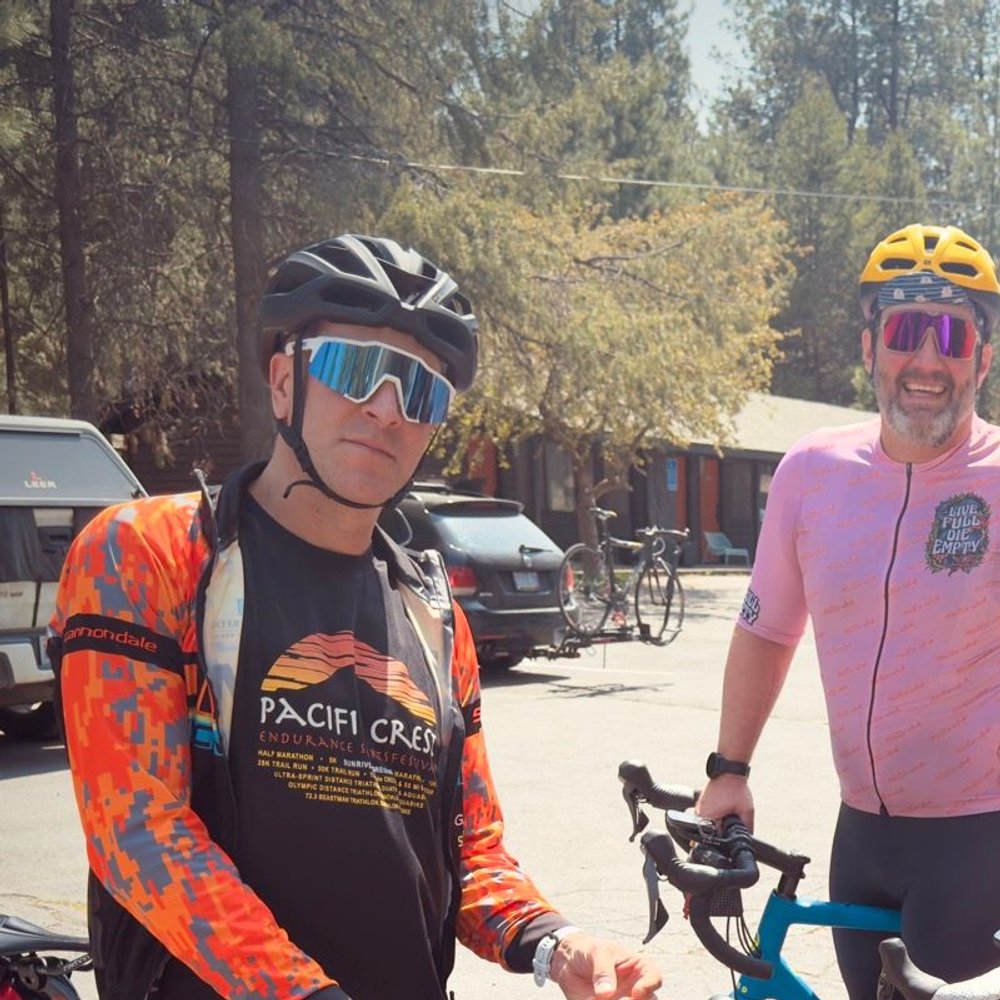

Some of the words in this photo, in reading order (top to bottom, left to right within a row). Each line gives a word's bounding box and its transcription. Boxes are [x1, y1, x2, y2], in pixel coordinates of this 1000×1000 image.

[24, 480, 57, 489] LEER
[949, 504, 978, 517] LIVE
[942, 515, 981, 529] FULL
[947, 528, 971, 541] DIE
[932, 540, 981, 555] EMPTY
[259, 730, 353, 753] ENDURANCE
[257, 750, 274, 758] HALF
[276, 751, 314, 761] MARATHON
[293, 762, 308, 770] RUN
[288, 781, 318, 791] OLYMPIC
[319, 784, 349, 794] DISTANCE
